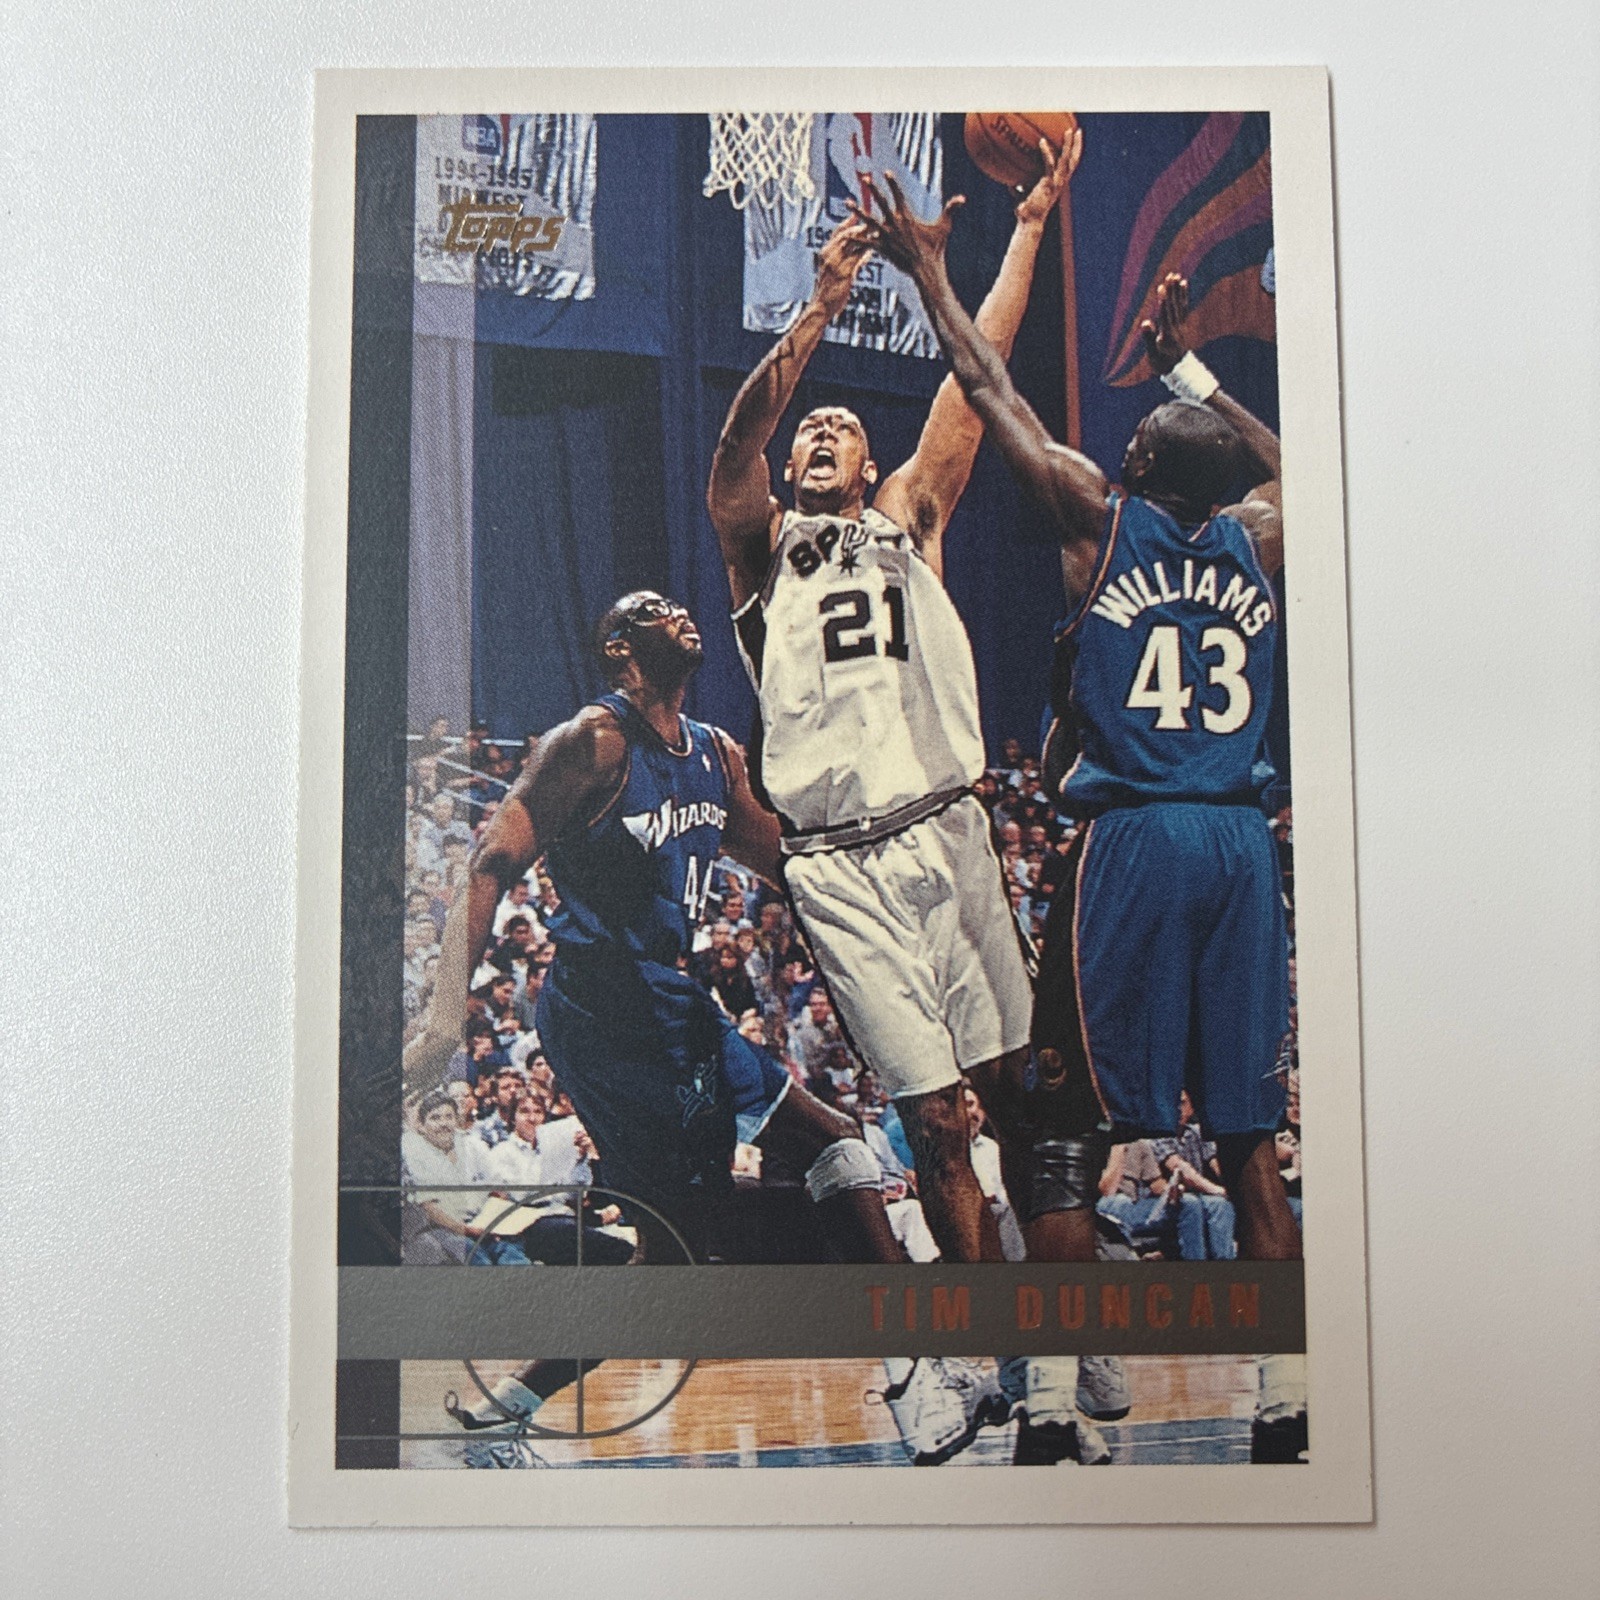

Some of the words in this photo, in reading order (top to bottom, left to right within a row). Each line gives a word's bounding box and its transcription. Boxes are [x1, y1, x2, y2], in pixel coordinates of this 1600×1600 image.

[819, 585, 909, 663] 21
[1090, 559, 1272, 637] WILLIAMS
[1126, 625, 1252, 734] 43
[621, 799, 728, 853] WIZARDS
[864, 1285, 971, 1331] TIM
[1016, 1283, 1261, 1331] DUNCAN
